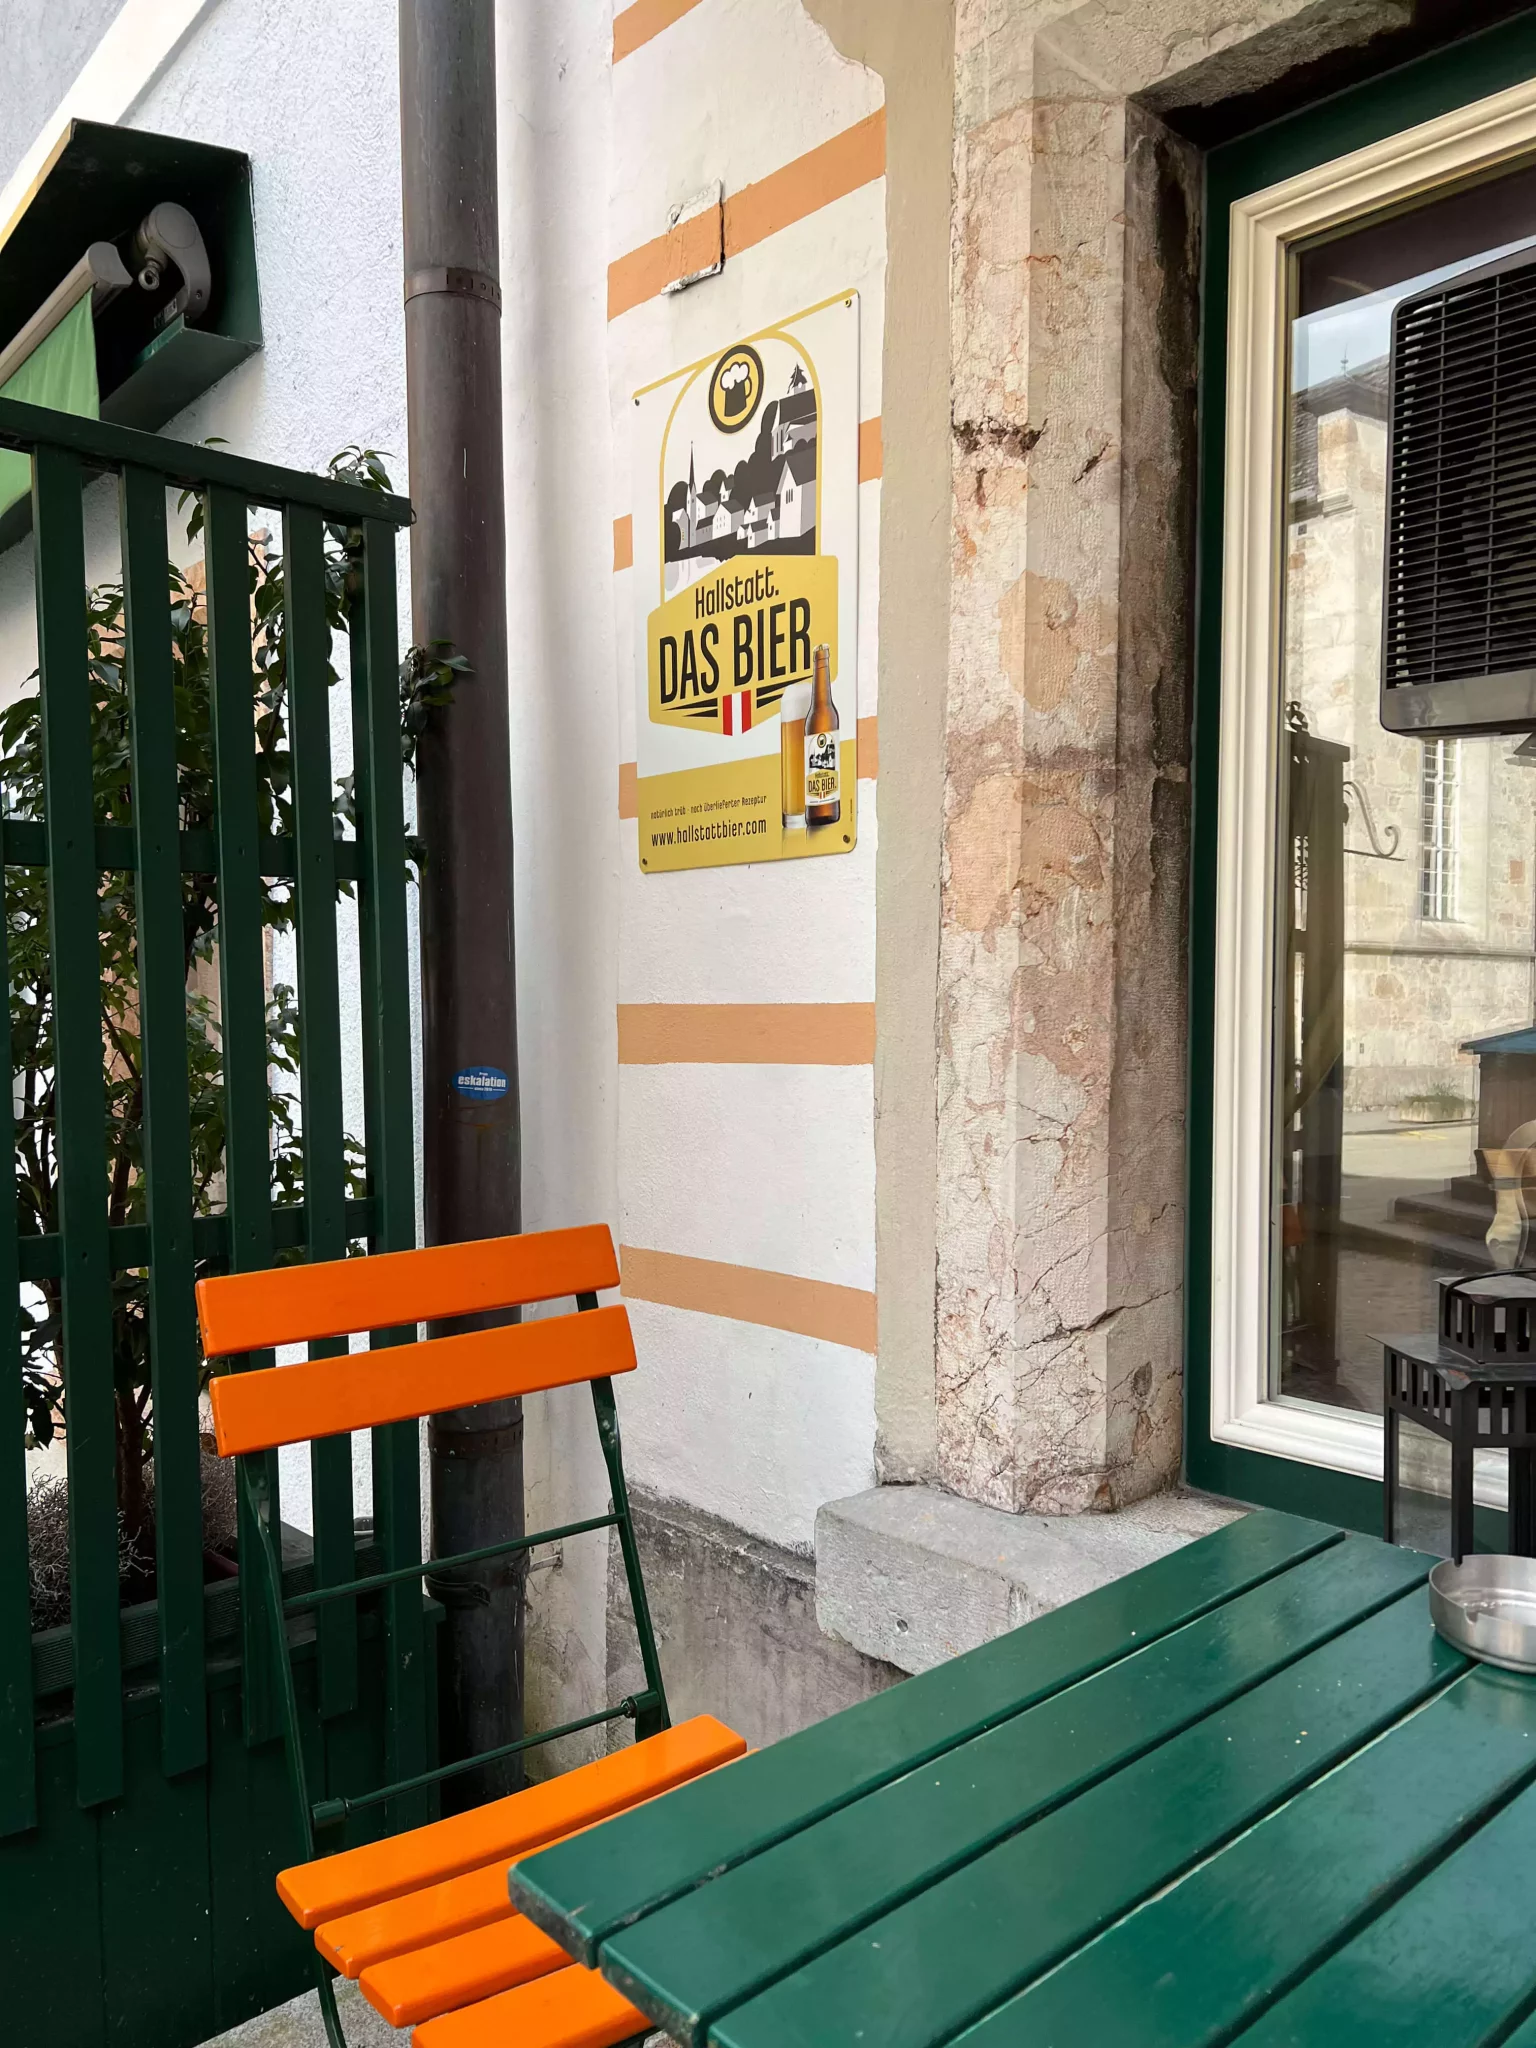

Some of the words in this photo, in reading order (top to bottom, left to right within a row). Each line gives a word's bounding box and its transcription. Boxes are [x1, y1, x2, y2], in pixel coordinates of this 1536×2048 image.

[695, 566, 780, 620] Hallstatt.
[659, 622, 720, 705] DAS
[733, 597, 811, 687] BIER
[808, 779, 820, 793] DAS
[690, 802, 703, 813] nach
[703, 799, 740, 812] überlieferter
[741, 795, 767, 807] Rezeptur
[651, 818, 767, 847] www.hallstattbier.com
[457, 1075, 506, 1088] eskalation
